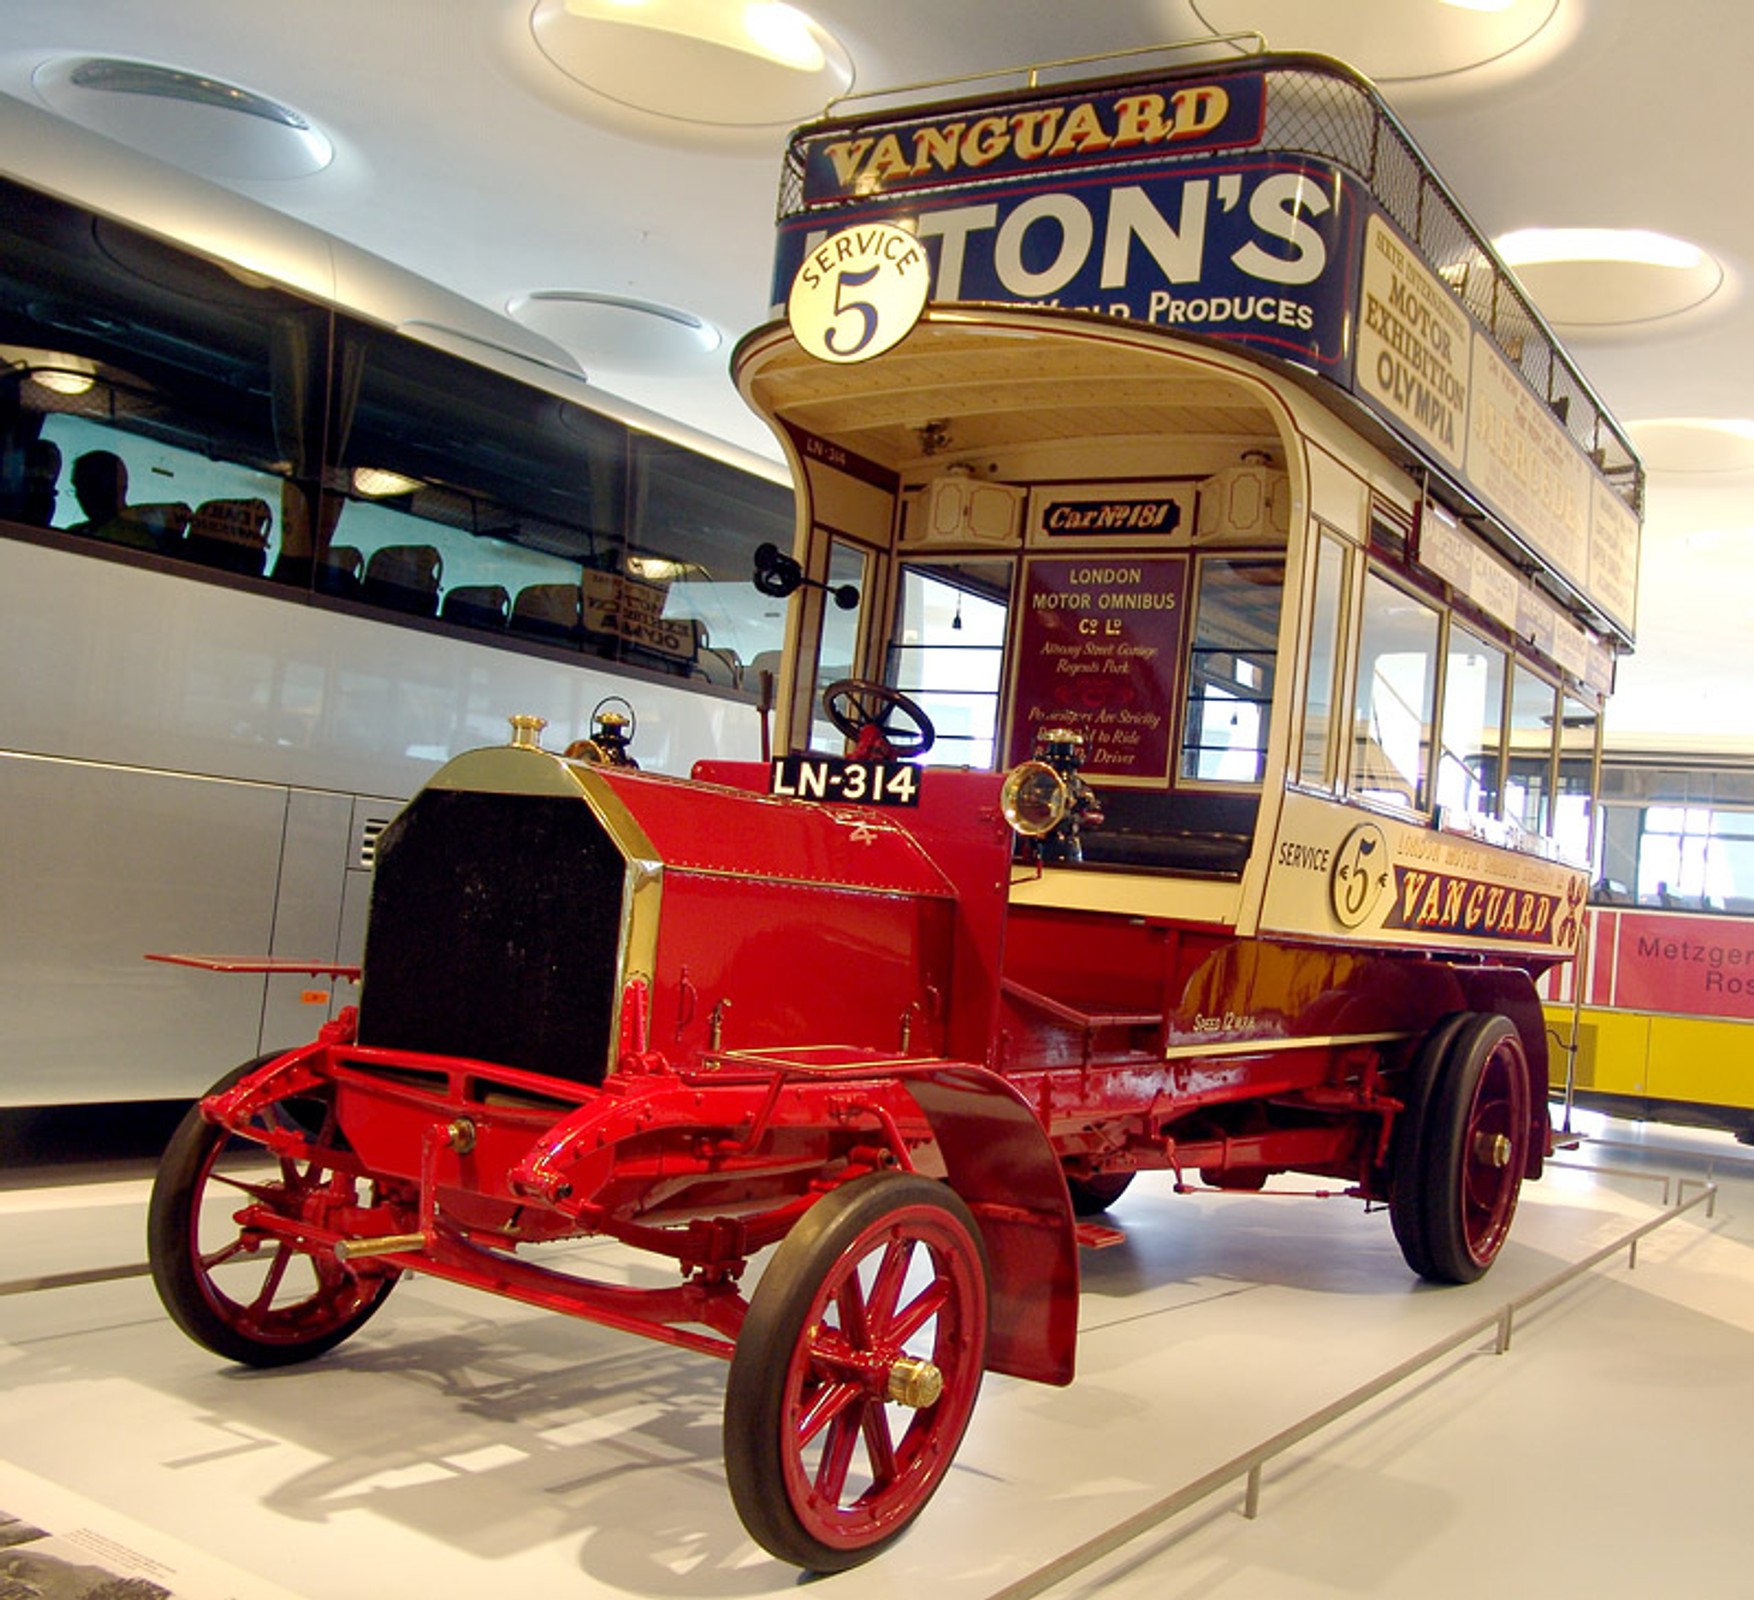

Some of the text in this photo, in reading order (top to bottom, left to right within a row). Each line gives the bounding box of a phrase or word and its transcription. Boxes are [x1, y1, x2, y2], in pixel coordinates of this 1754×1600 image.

[823, 84, 1229, 185] VANGUARD
[802, 230, 919, 290] SERVICE
[824, 264, 880, 357] 5
[1148, 291, 1314, 330] PRODUCES
[1388, 273, 1453, 365] MOTOR
[1365, 291, 1465, 414] EXHIBITION
[1376, 350, 1455, 450] OLYMPIA
[1050, 506, 1099, 529] Car
[1127, 502, 1169, 529] 181
[1069, 568, 1142, 585] LONDON
[1032, 592, 1176, 610] MOTOR OMNIBUS
[1083, 640, 1115, 656] Street
[1117, 642, 1158, 660] Garage
[1102, 658, 1130, 674] Park
[1095, 708, 1119, 724] Are
[1119, 709, 1161, 730] Strictly
[1098, 731, 1111, 743] to
[1112, 729, 1141, 746] Ride
[1094, 748, 1136, 764] Driver
[773, 761, 917, 802] LN-314
[1278, 838, 1376, 914] SERVICE 5
[1402, 871, 1552, 937] VANGUARD
[1638, 937, 1754, 968] Metzger
